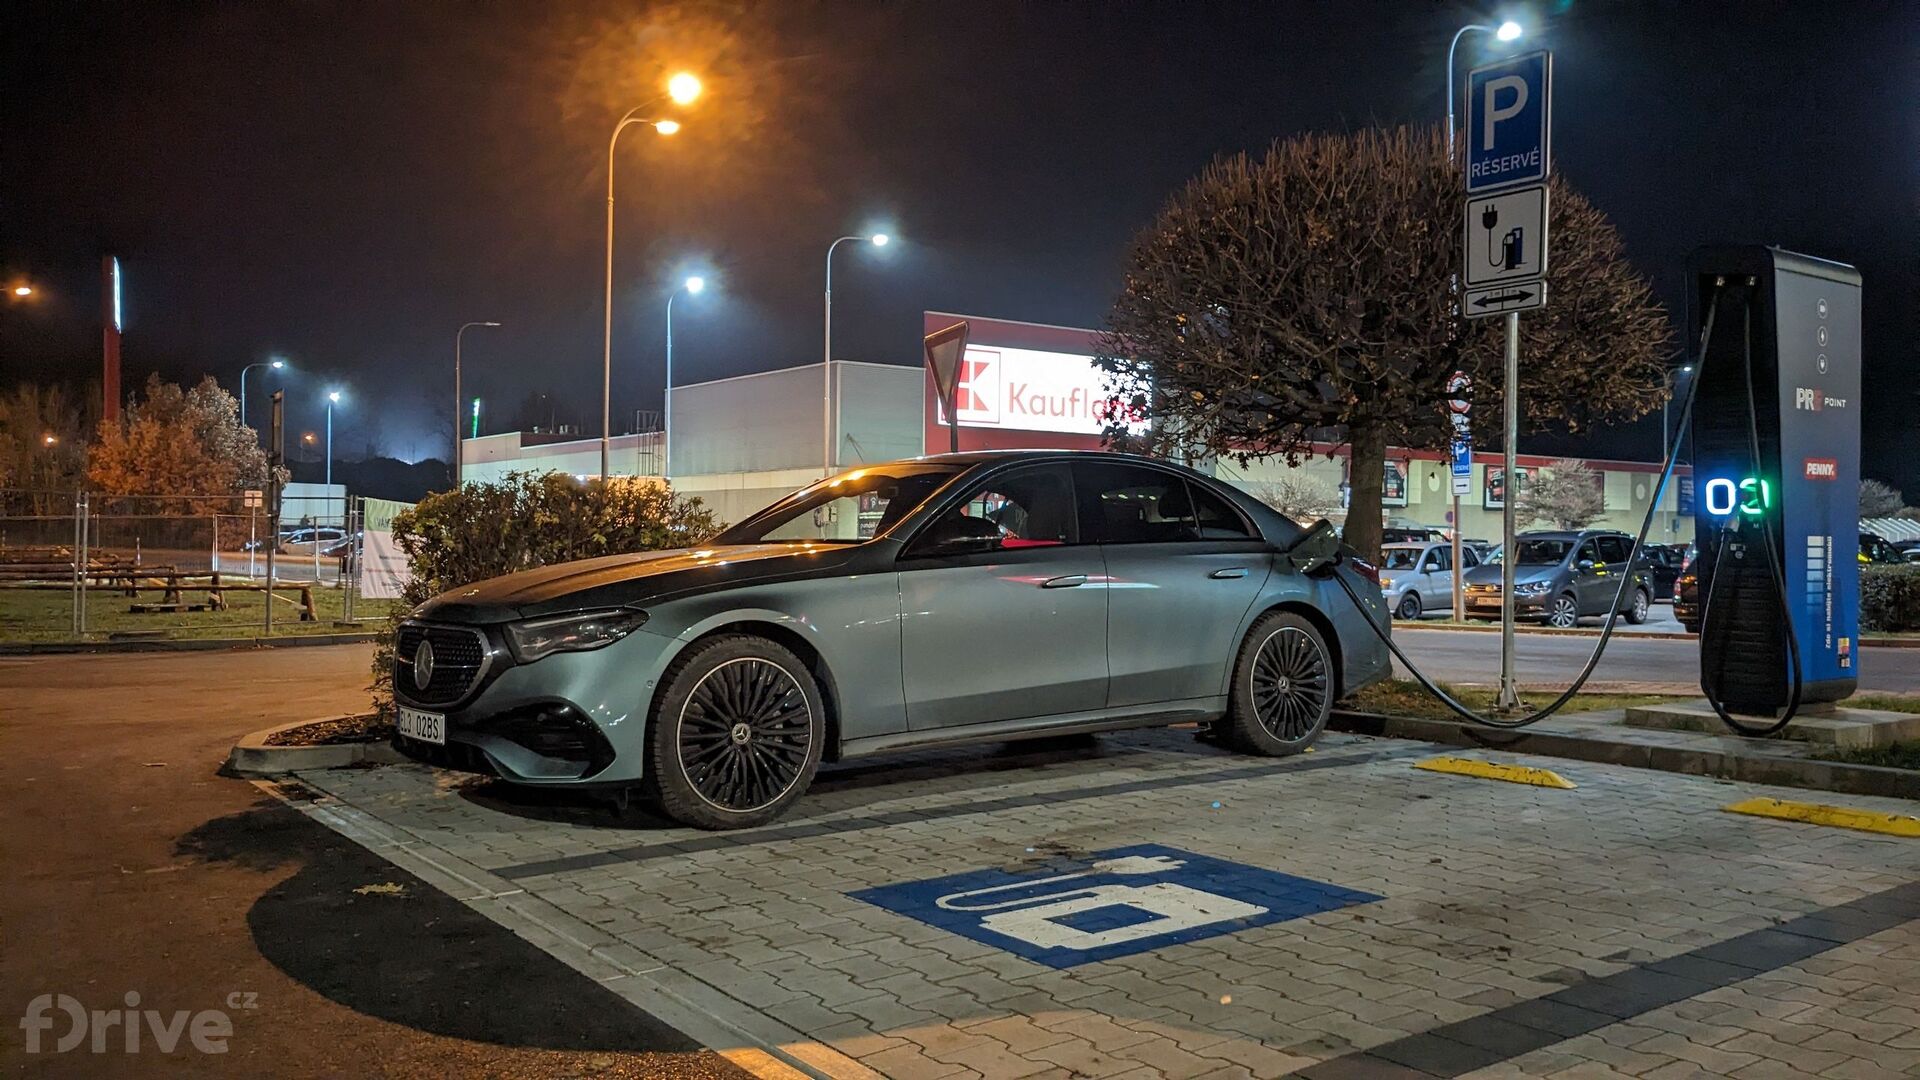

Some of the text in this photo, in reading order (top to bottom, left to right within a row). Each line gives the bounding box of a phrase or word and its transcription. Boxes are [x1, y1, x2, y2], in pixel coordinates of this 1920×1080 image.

[1483, 75, 1529, 151] P
[1471, 146, 1540, 178] RÉSERVÉ
[1824, 397, 1847, 408] POINT
[416, 714, 439, 740] 02BS
